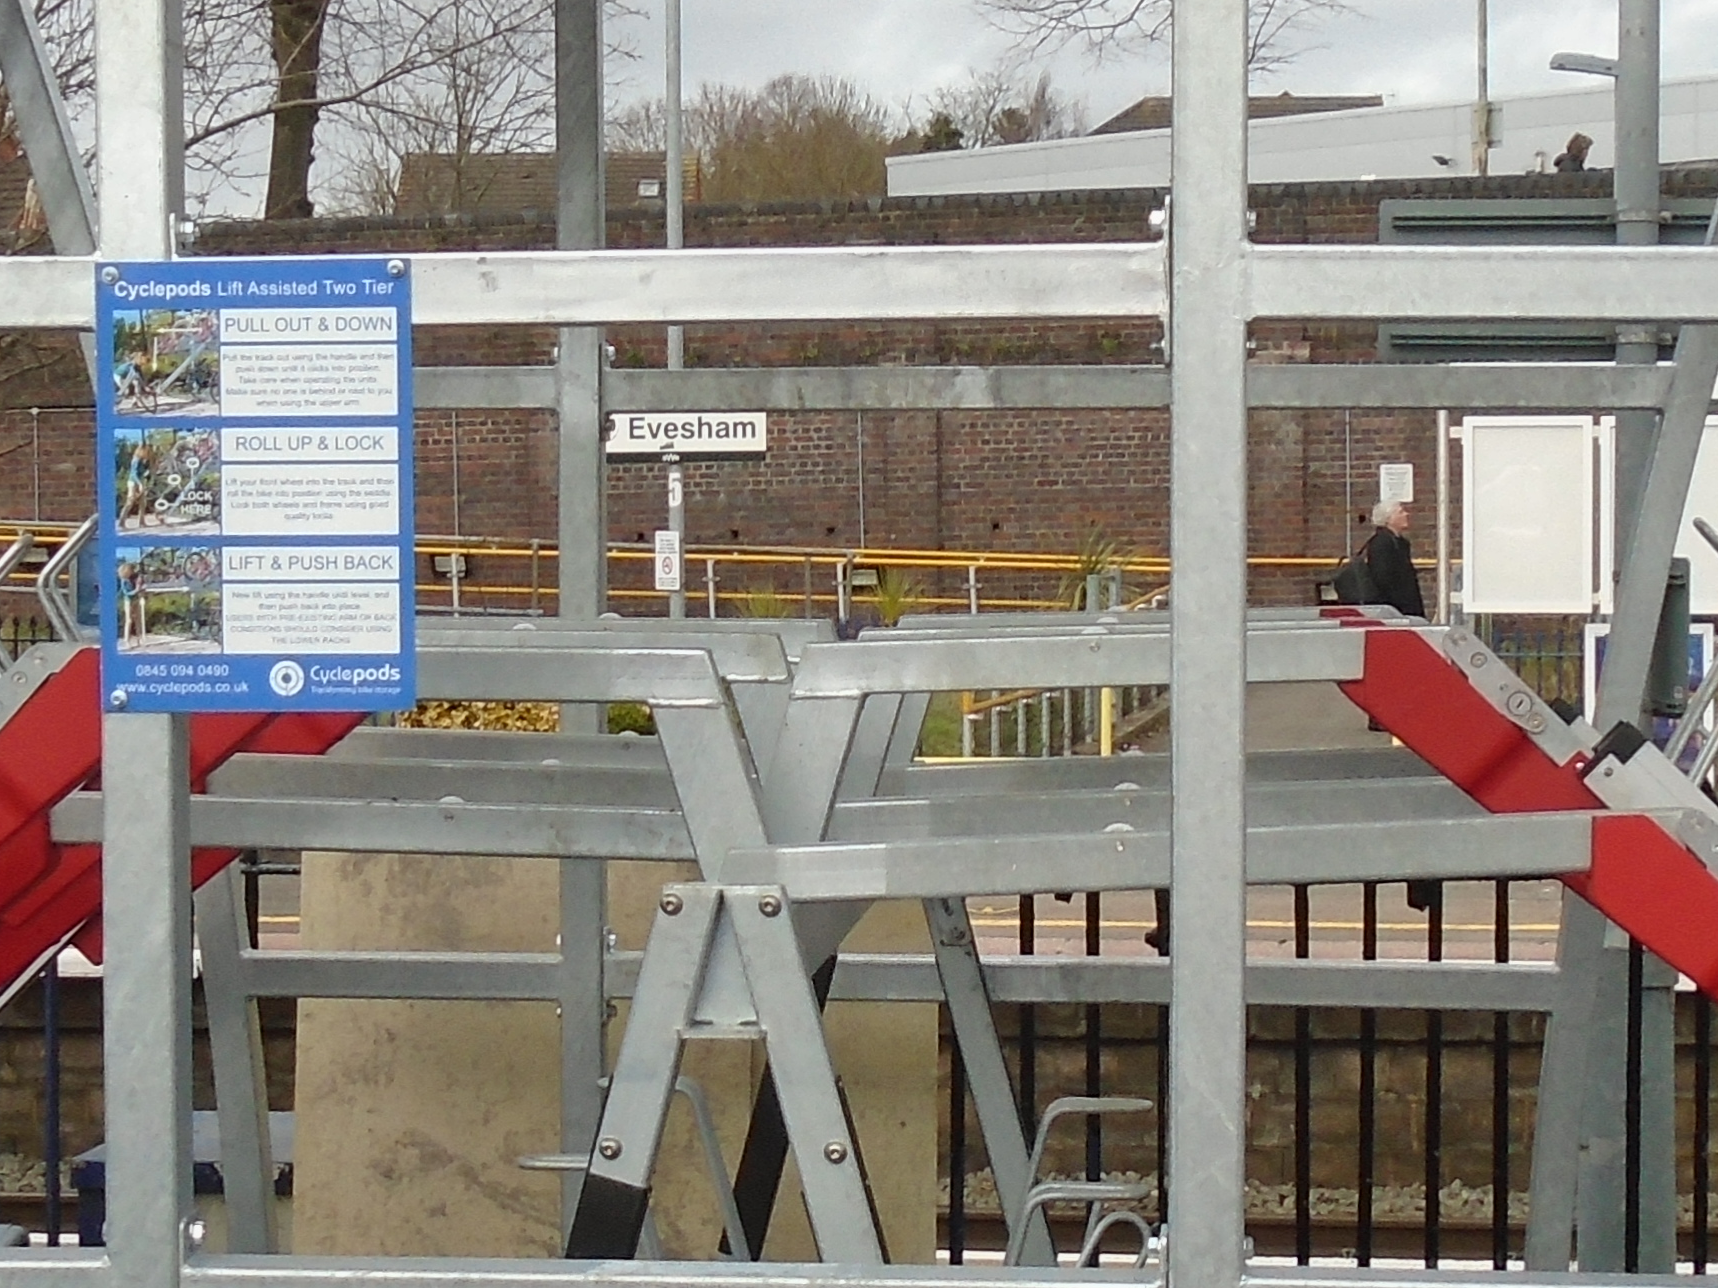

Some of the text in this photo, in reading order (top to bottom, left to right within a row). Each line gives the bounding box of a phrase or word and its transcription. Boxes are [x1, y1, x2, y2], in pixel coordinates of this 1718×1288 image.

[114, 279, 394, 300] Cyclepods Lift Assisted Two Tier
[225, 316, 392, 332] PULL OUT & DOWN
[629, 417, 756, 439] Evesham
[236, 436, 384, 451] ROLL UP & LOCK
[182, 491, 212, 500] LOCK
[668, 472, 682, 507] 5
[180, 504, 211, 514] HERE
[229, 555, 393, 570] LIFT & PUSH BACK
[136, 665, 229, 677] 0845 094 0490
[310, 664, 401, 685] Cyclepods
[117, 681, 249, 695] www.cyclepods.co.uk
